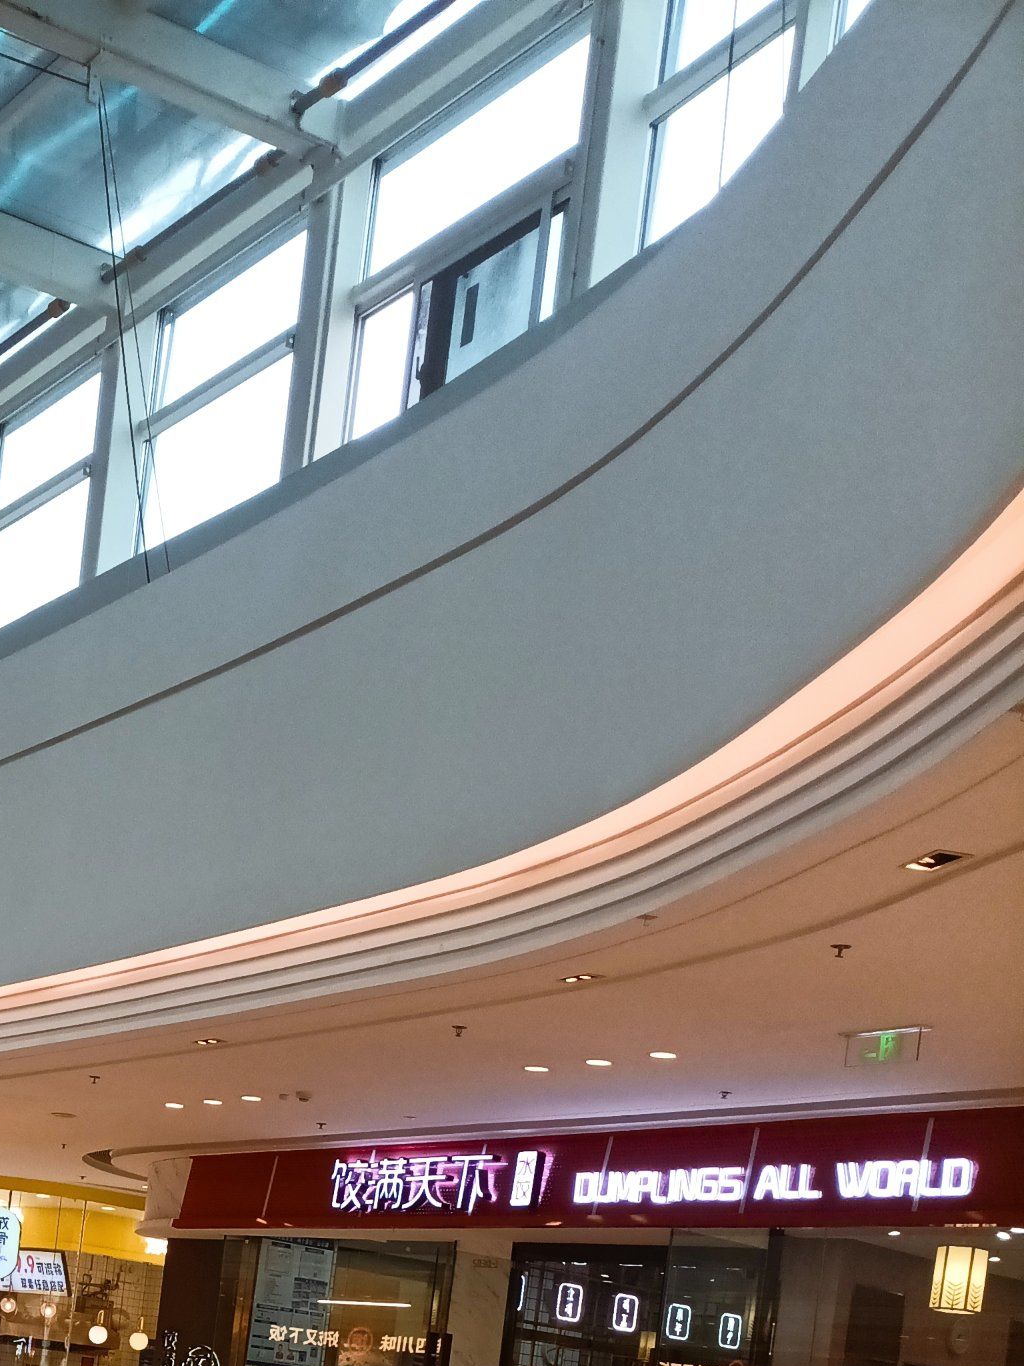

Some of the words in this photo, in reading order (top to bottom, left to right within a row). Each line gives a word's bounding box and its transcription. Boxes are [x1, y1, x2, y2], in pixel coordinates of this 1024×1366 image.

[331, 1155, 494, 1213] 饺满天下
[573, 1166, 746, 1205] DUMPLINGS
[753, 1163, 823, 1200] ALL
[836, 1157, 975, 1198] WORLD
